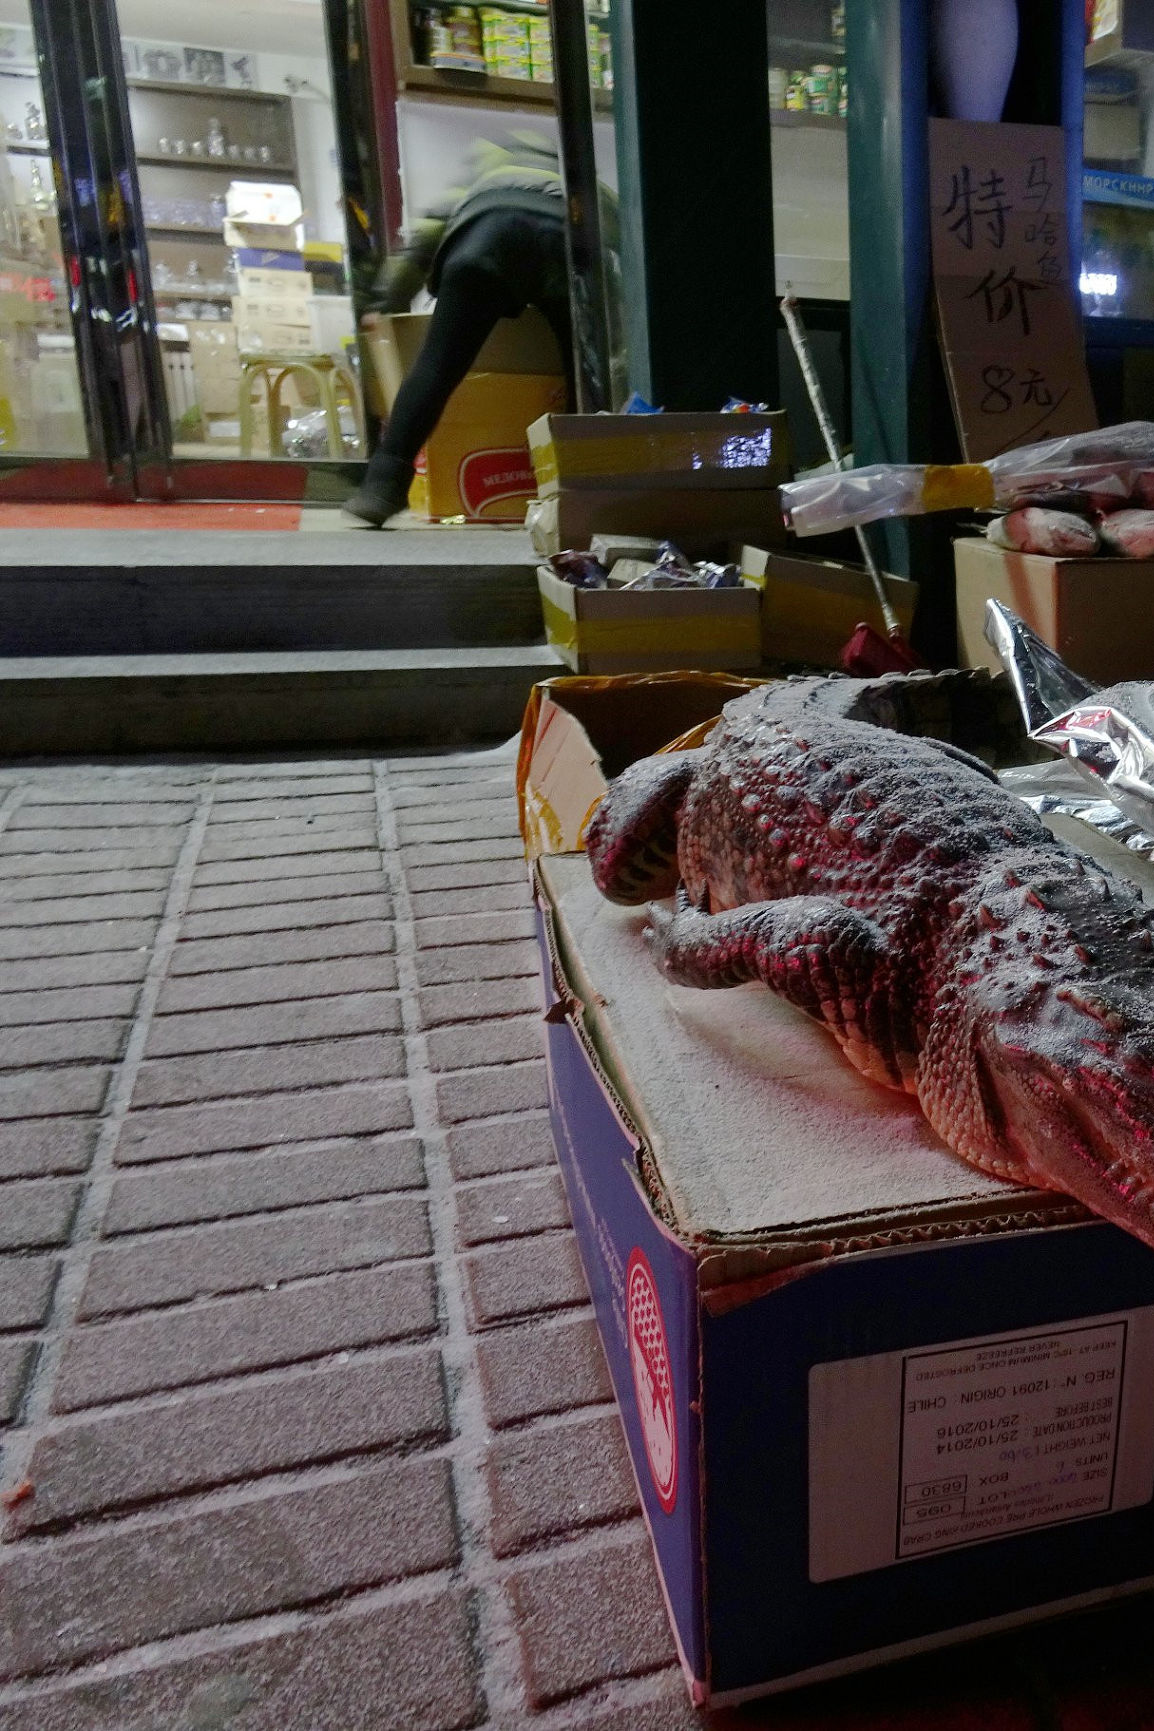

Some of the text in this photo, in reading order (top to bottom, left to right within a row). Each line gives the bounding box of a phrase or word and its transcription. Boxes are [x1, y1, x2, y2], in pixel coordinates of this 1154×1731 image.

[942, 165, 1047, 336] 特价
[976, 1341, 1059, 1361] NEVER REFREEZE
[979, 1360, 1005, 1371] ONCE
[1008, 1352, 1050, 1366] MINIMUM
[1081, 1368, 1115, 1384] REG.
[961, 1386, 1006, 1403] ORIGIN
[1012, 1379, 1050, 1395] 12091
[907, 1397, 946, 1413] CHILE
[1055, 1402, 1089, 1417] BEFORE
[1091, 1397, 1112, 1411] BEST
[936, 1412, 1112, 1454] PRODUCTION DATE 25/10/2014
[1091, 1432, 1110, 1445] NET
[1044, 1437, 1086, 1454] WEIGHT
[1075, 1452, 1108, 1464] UNITS
[979, 1472, 1008, 1484] BOX
[1083, 1467, 1107, 1481] SIZE
[916, 1492, 1007, 1517] LOT 095
[1029, 1503, 1063, 1518] WHOLE
[935, 1526, 959, 1538] KING
[963, 1517, 1003, 1532] COOKED
[904, 1534, 931, 1545] CRAB
